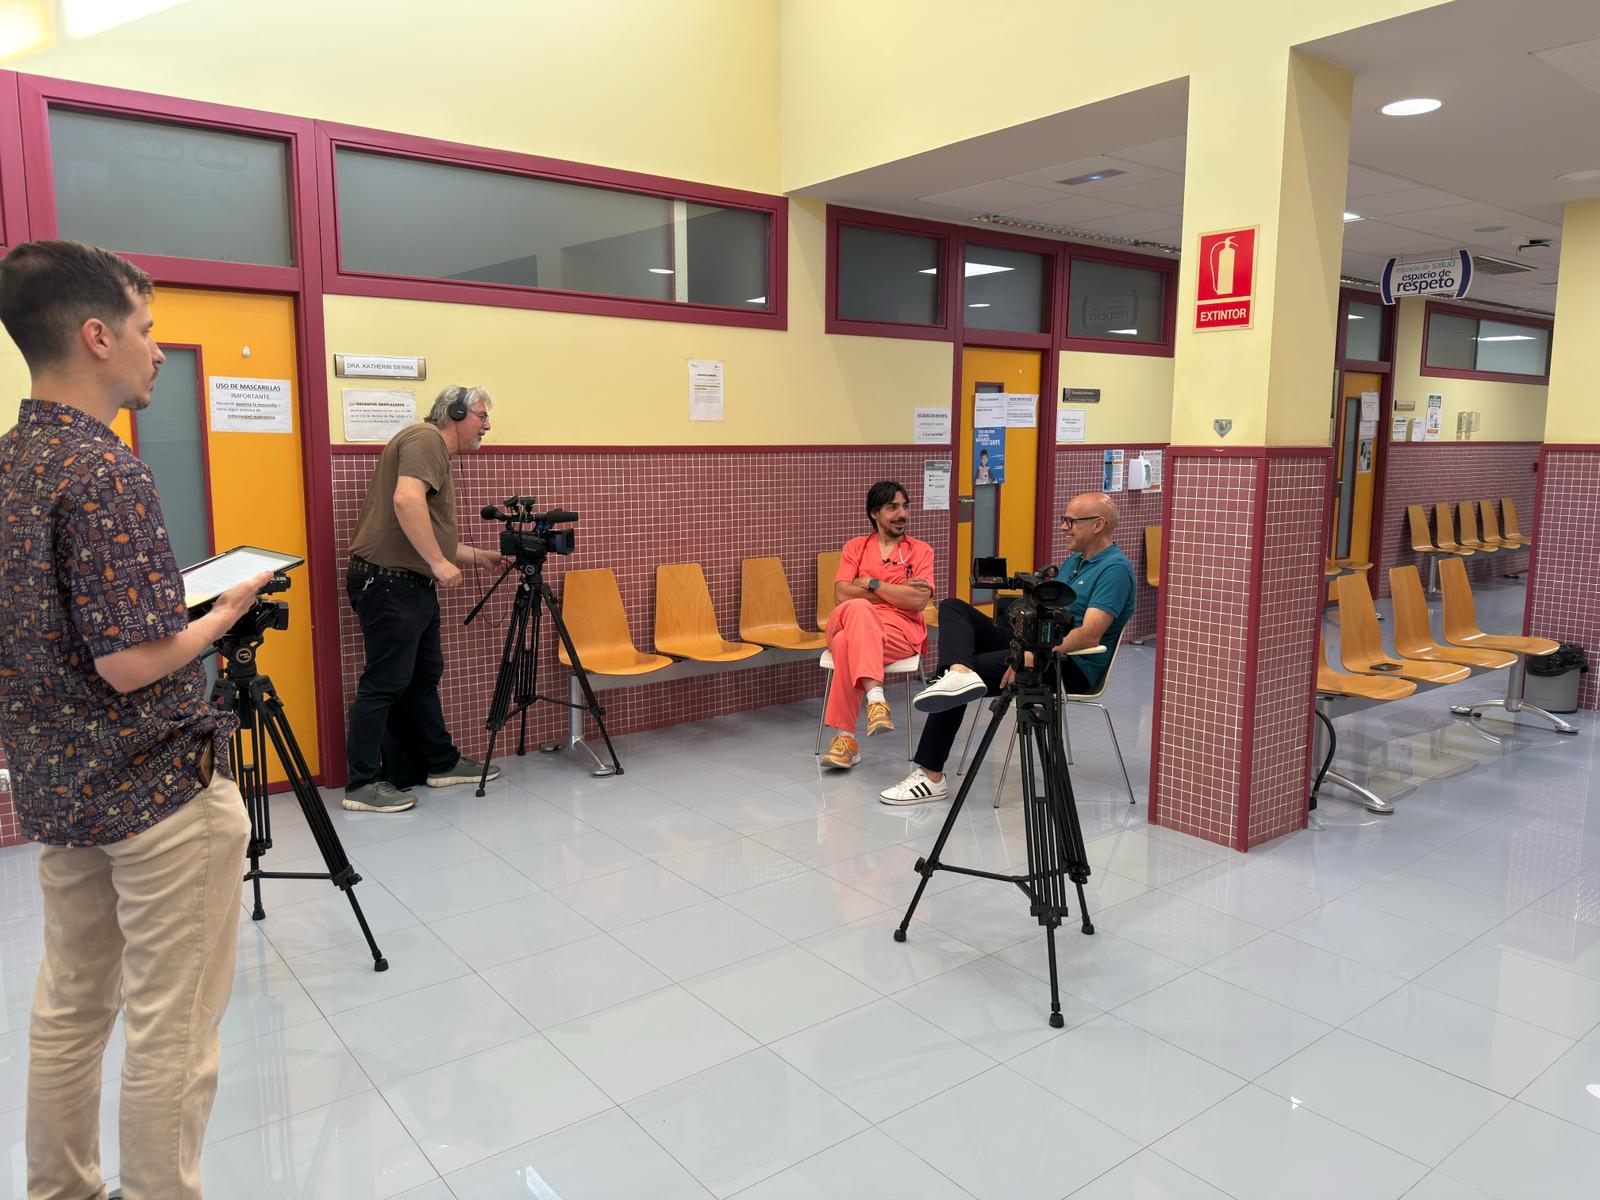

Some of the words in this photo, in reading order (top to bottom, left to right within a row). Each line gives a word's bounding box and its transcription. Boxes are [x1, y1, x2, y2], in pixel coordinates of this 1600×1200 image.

[1432, 259, 1456, 270] salud
[1402, 270, 1437, 283] espacio
[1439, 269, 1451, 278] de
[1397, 277, 1455, 294] respeto
[1200, 308, 1247, 322] EXTINTOR
[239, 383, 281, 391] MASCARILLAS
[231, 392, 271, 400] IMPORTANTE
